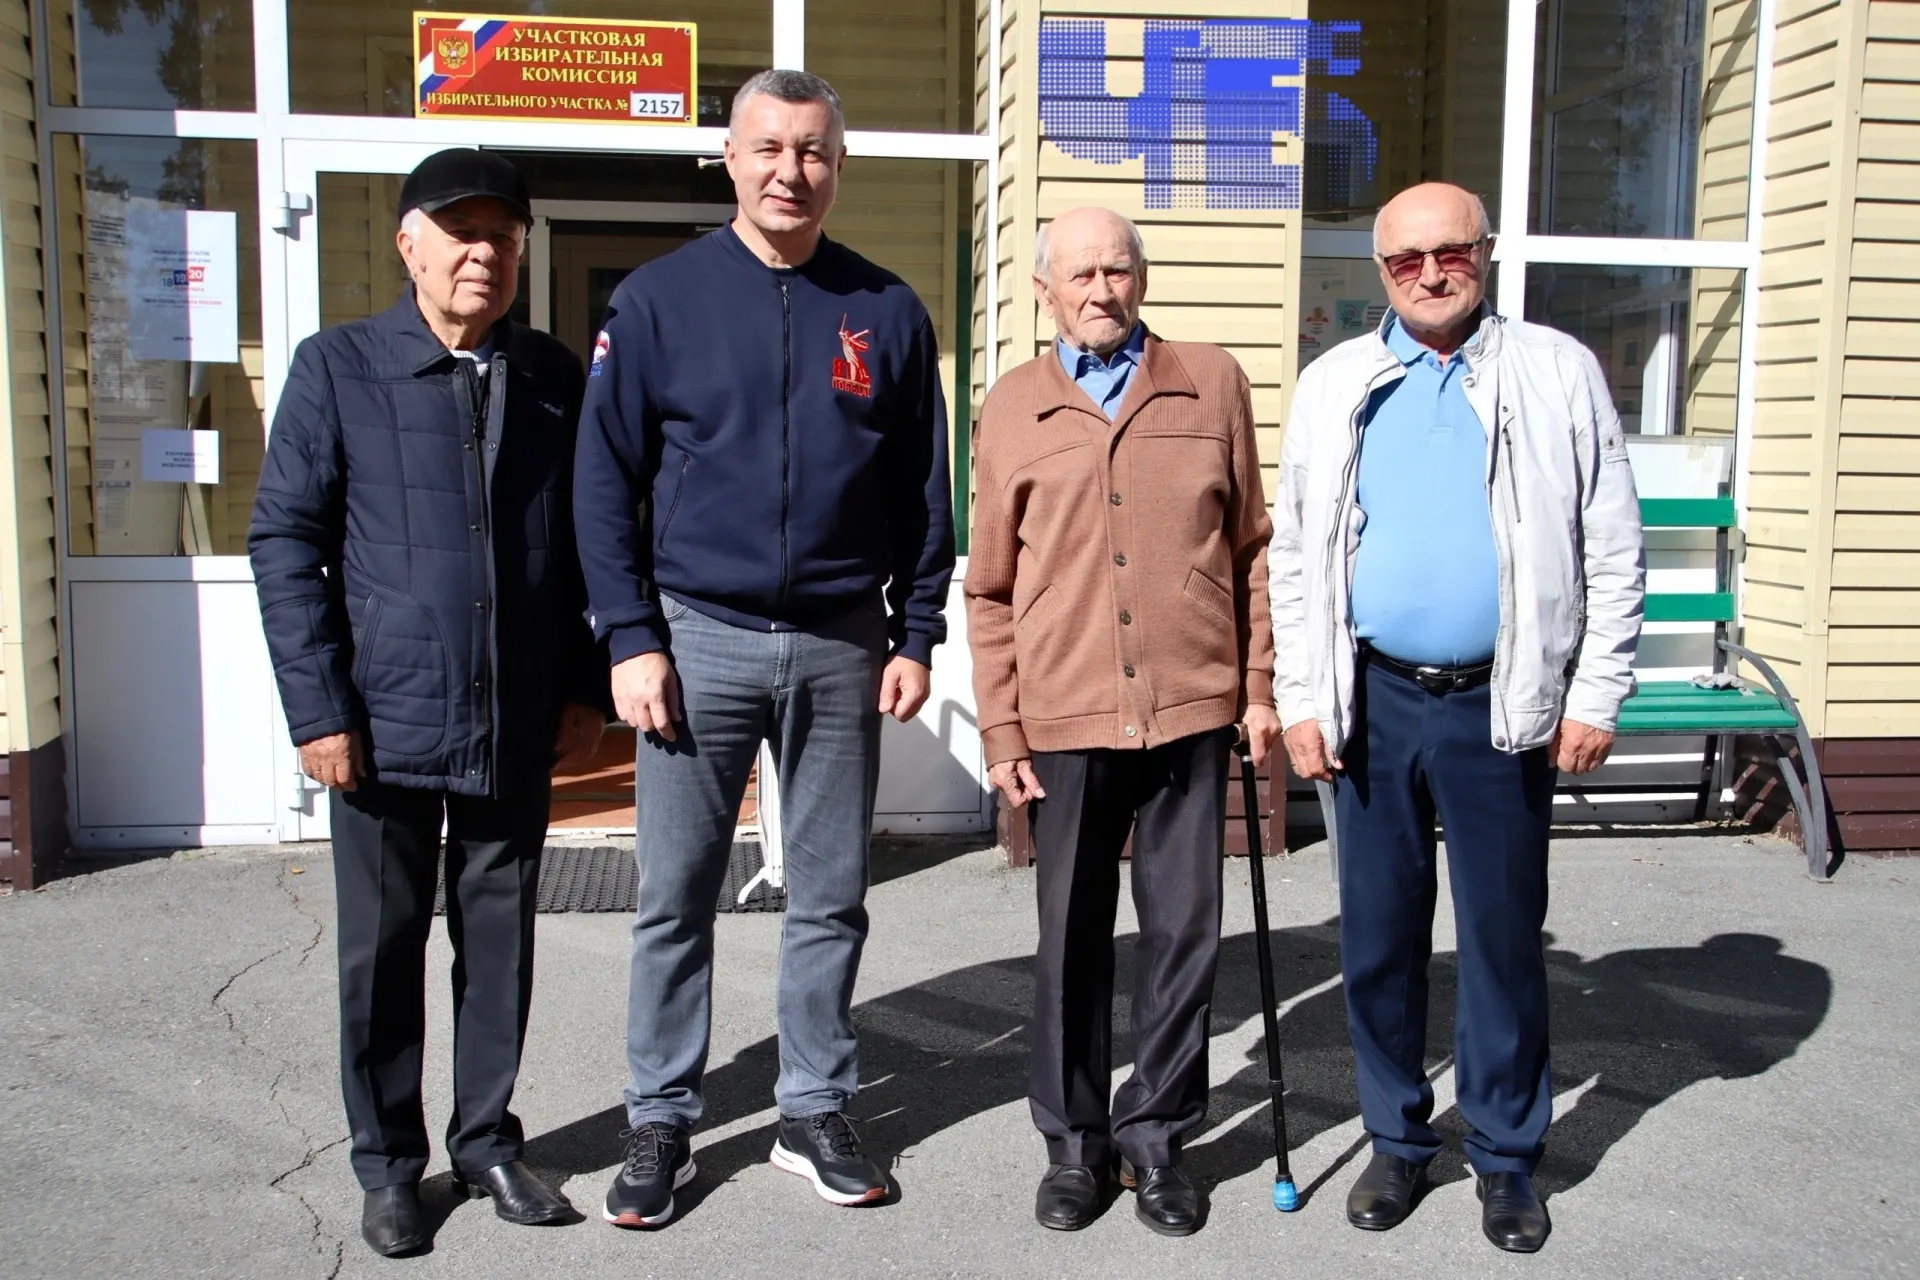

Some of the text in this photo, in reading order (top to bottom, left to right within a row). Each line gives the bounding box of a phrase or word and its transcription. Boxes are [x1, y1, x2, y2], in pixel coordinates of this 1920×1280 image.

[512, 28, 646, 47] УЧАСТКОВАЯ
[495, 47, 663, 67] ИЗБИРАТЕЛЬНАЯ
[521, 67, 638, 85] КОМИССИЯ
[426, 92, 547, 108] ИЗБИРАТЕЛЬНОГО
[550, 97, 612, 111] УЧАСТКА
[638, 98, 681, 116] 2157
[188, 269, 203, 280] 20
